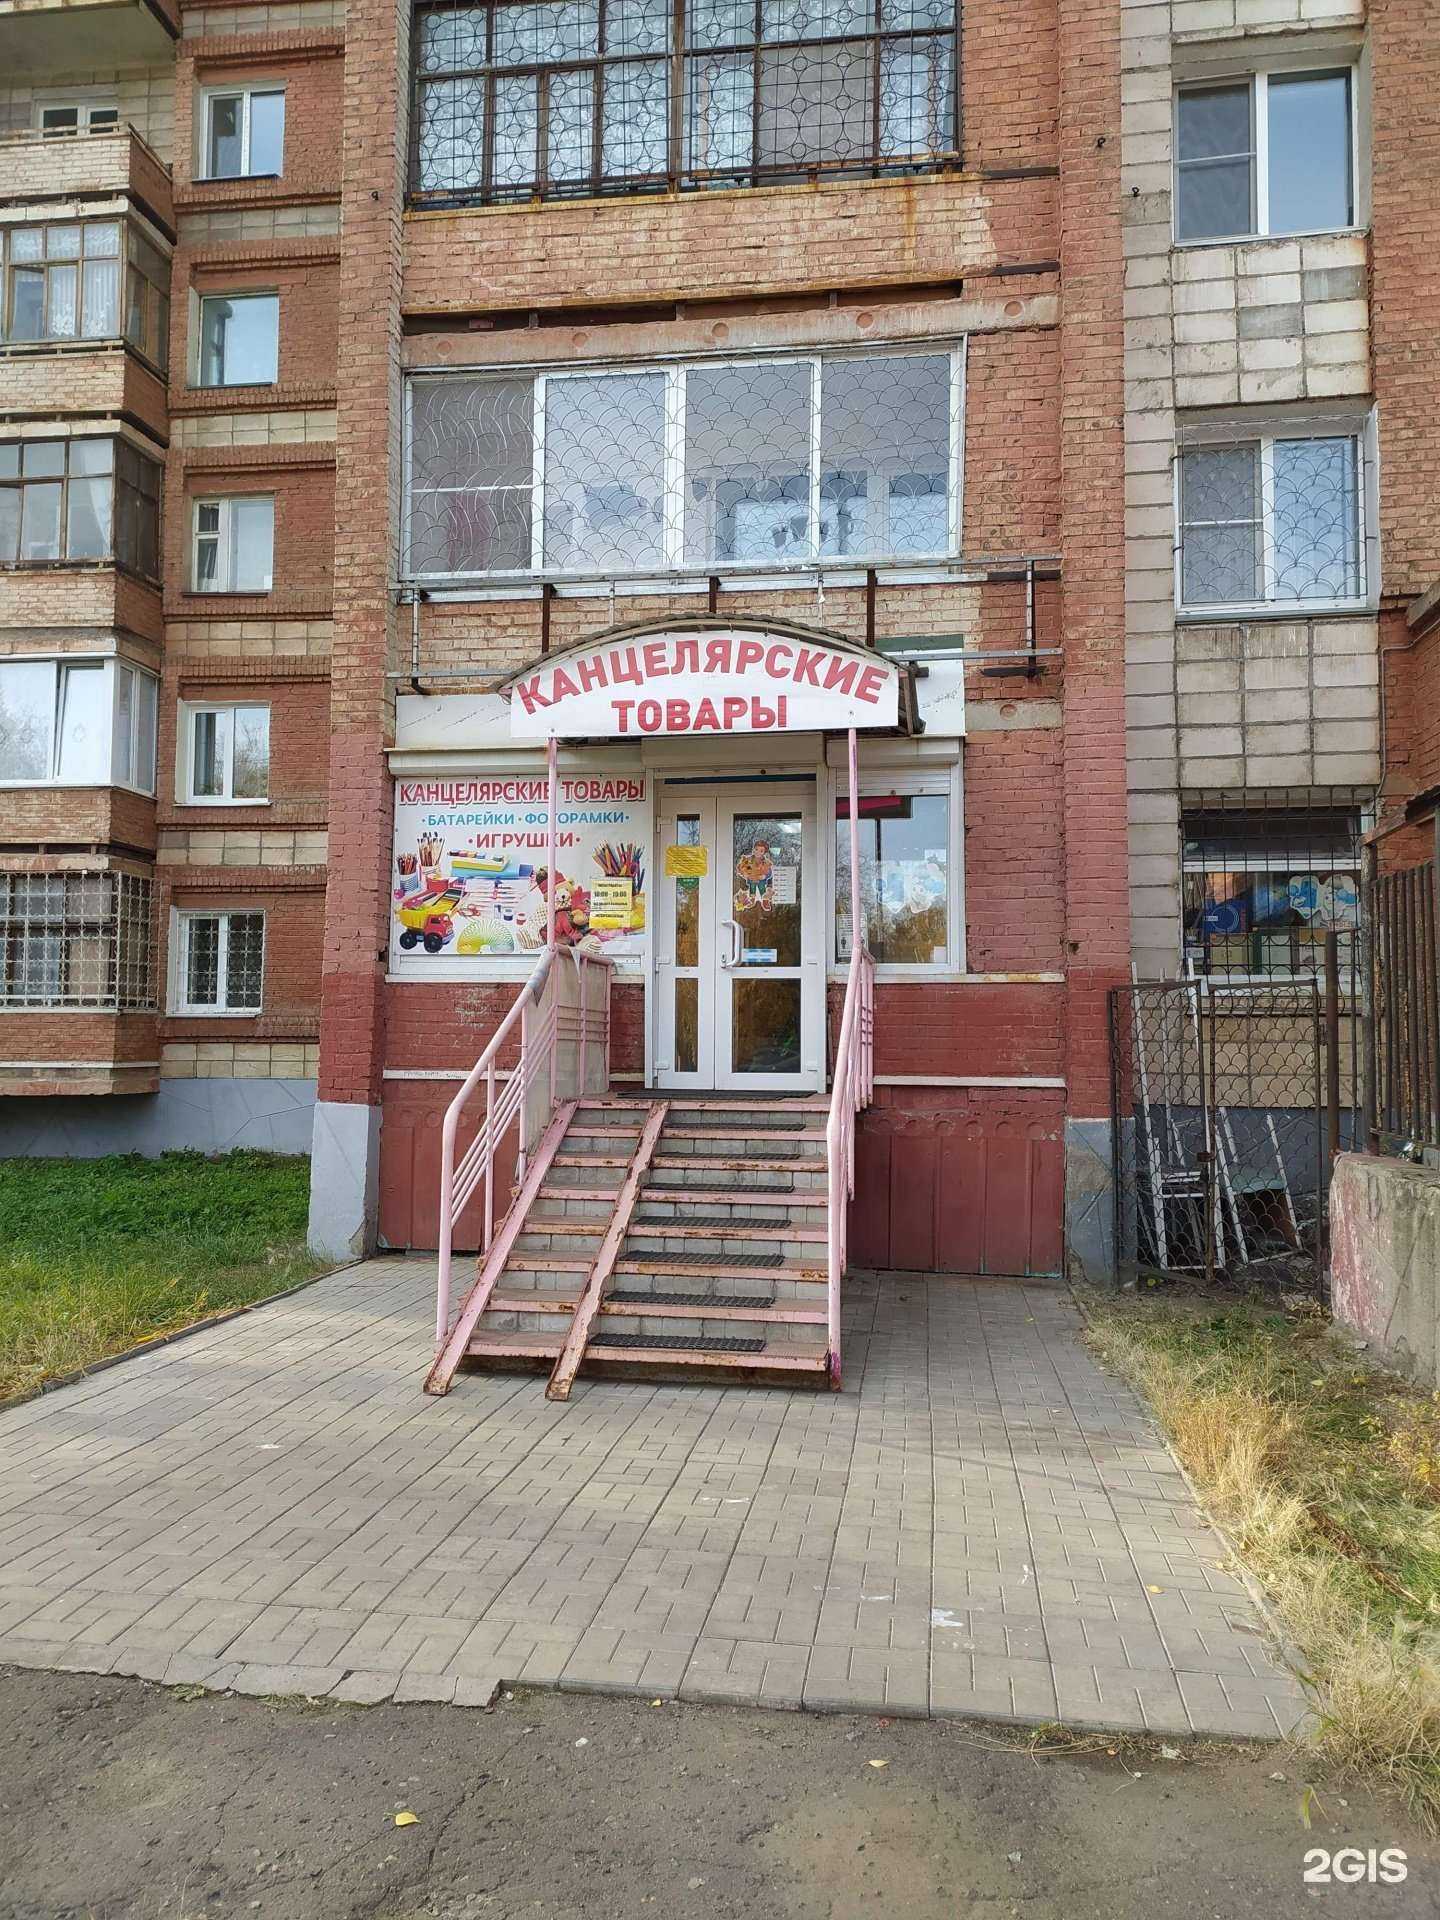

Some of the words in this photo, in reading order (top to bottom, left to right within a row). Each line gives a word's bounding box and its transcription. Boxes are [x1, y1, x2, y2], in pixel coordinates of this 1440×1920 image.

[515, 639, 890, 715] КАНЦЕЛЯРСКИЕ
[611, 695, 787, 733] ТОВАРЫ
[399, 781, 550, 807] КАНЦЕЛЯРСКИЕ
[560, 779, 646, 803] ТОВАРЫ
[427, 811, 515, 827] БАТАРЕЙКИ
[525, 812, 625, 825] ФООРАМКИ
